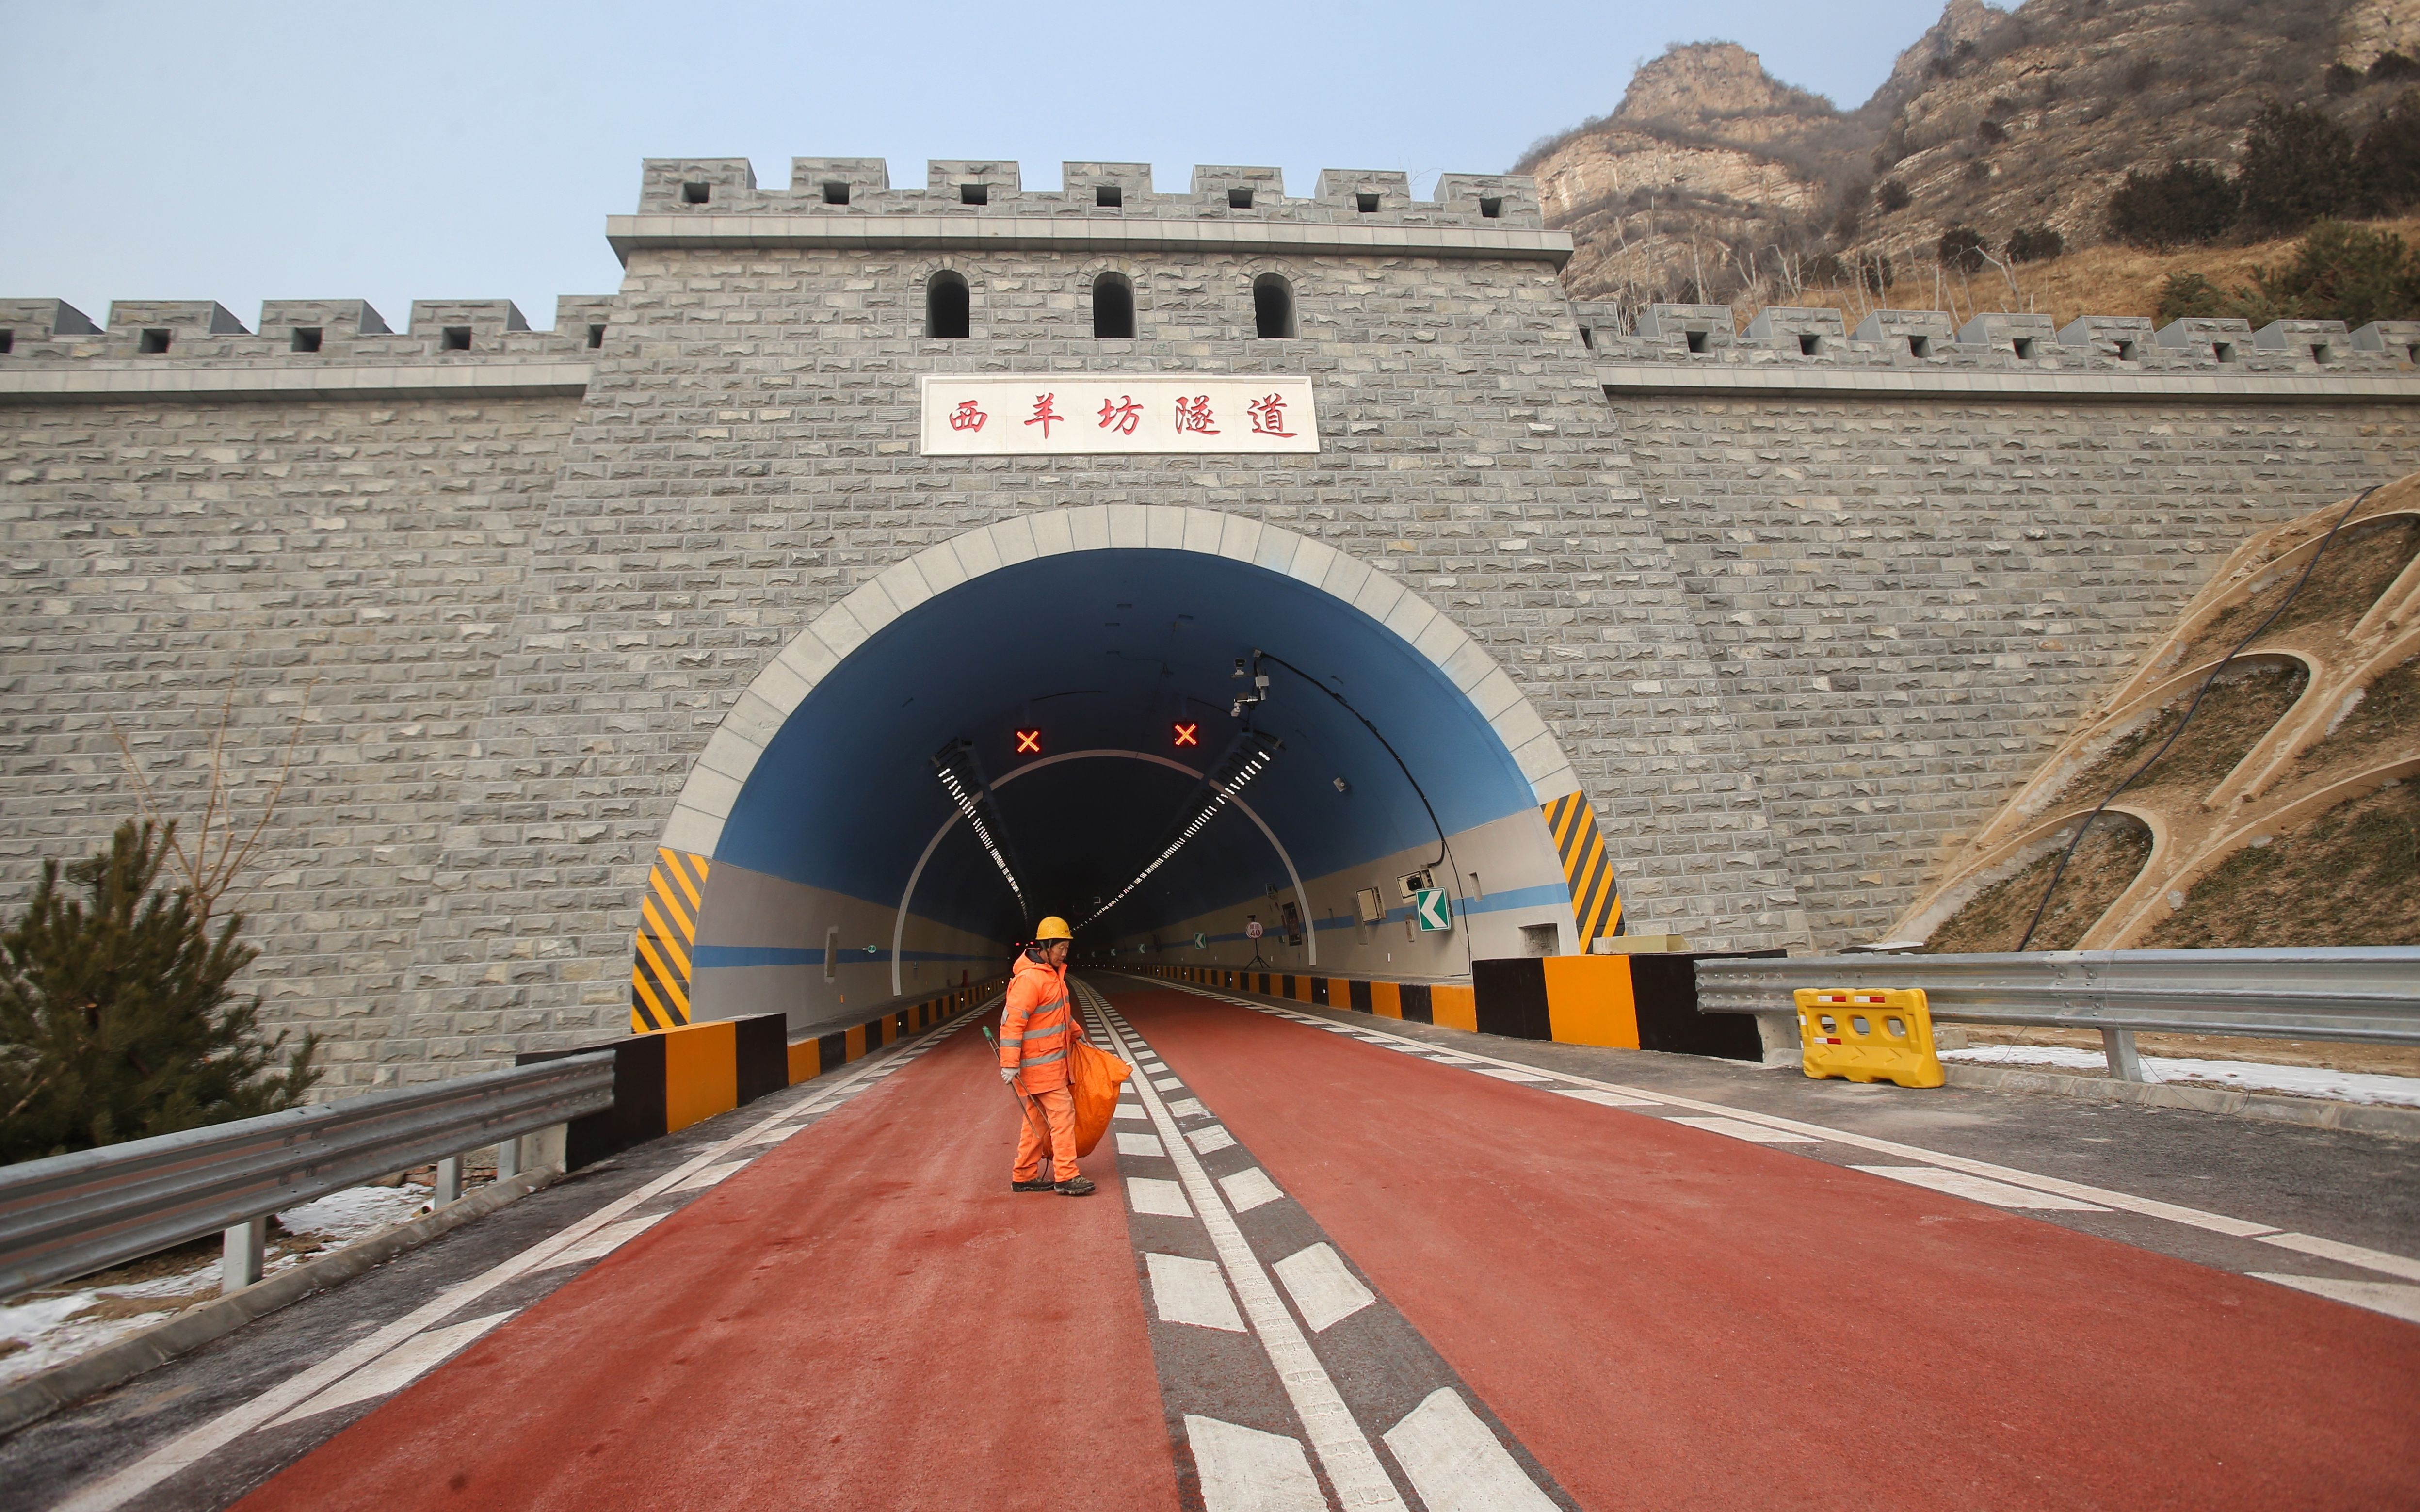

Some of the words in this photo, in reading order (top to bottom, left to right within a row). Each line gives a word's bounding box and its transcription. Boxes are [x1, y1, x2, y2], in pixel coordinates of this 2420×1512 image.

[950, 393, 1297, 439] 西羊坊隧道
